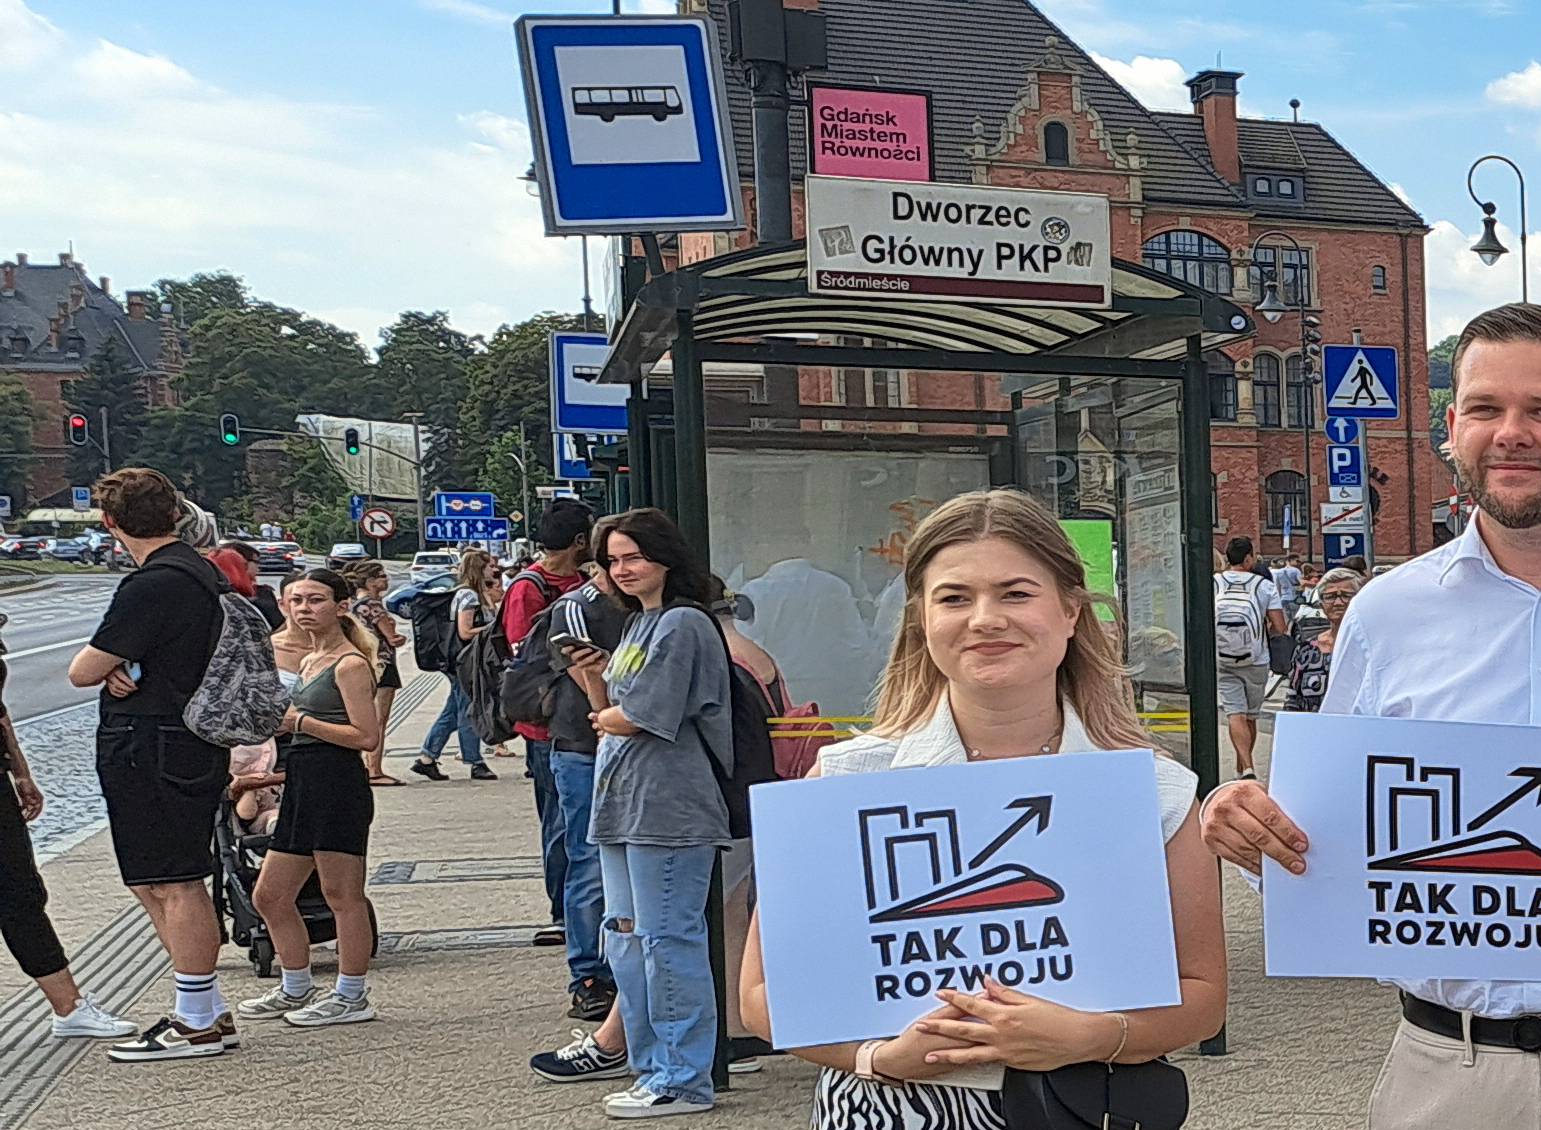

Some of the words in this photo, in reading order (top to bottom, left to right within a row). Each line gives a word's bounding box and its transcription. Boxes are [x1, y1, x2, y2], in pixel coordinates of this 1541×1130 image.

[819, 105, 898, 127] Gdańsk
[820, 122, 907, 144] Miastem
[821, 140, 921, 161] Równości
[892, 191, 1031, 228] Dworzec
[861, 234, 985, 276] Główny
[996, 242, 1062, 273] PKP
[820, 273, 910, 291] Śródmieście
[1332, 448, 1351, 473] P
[1340, 535, 1355, 556] P
[1368, 881, 1458, 915] TAK
[871, 926, 968, 967] TAK
[980, 916, 1070, 956] DLA
[875, 954, 1074, 1001] ROZWOJU
